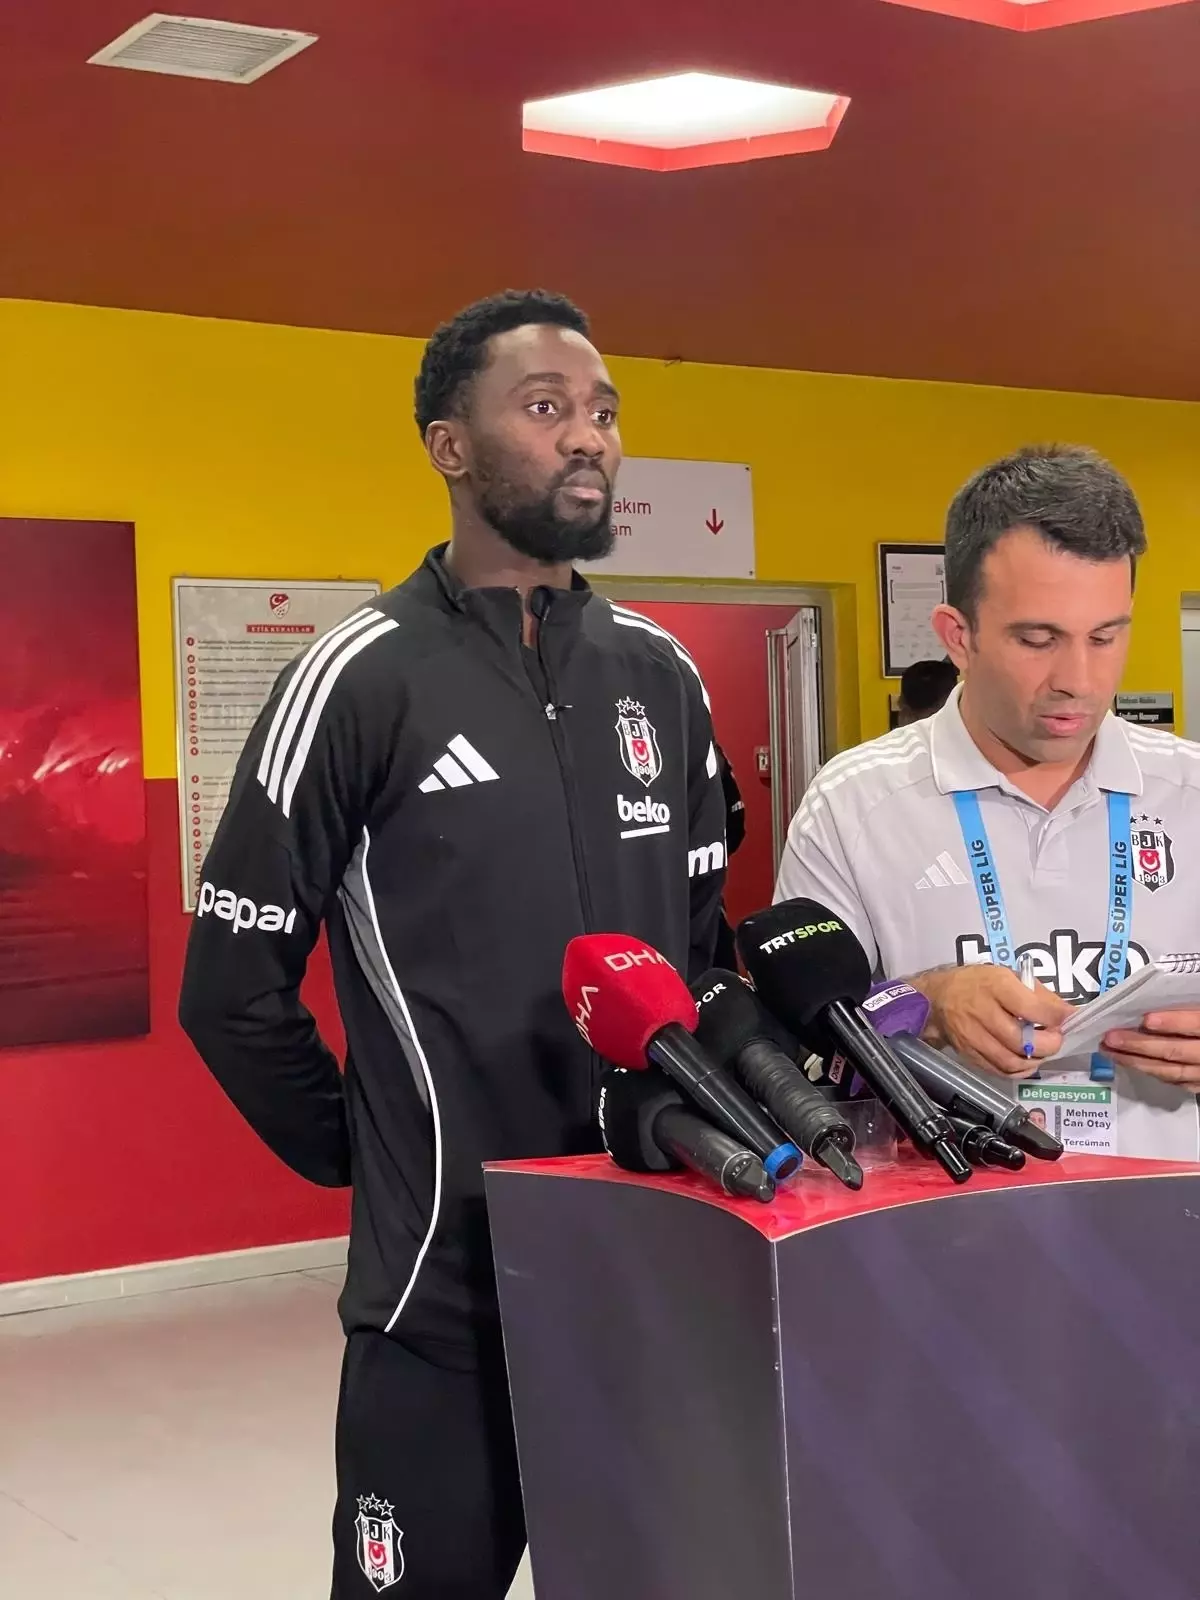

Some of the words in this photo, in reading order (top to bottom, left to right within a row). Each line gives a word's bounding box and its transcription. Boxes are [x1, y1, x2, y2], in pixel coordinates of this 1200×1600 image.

[613, 497, 652, 515] akım
[617, 794, 671, 824] beko
[1132, 833, 1164, 849] BJK
[1137, 873, 1167, 884] 1903
[980, 871, 1005, 932] SÜPER
[1108, 874, 1127, 933] SÜPER
[1105, 939, 1124, 991] DYOL
[1022, 1089, 1096, 1101] Delegasyon
[1099, 1090, 1107, 1101] 1
[1066, 1108, 1108, 1118] Mehmet
[1063, 1119, 1083, 1128] Can
[1087, 1119, 1111, 1130] Otay
[1064, 1138, 1110, 1147] Tercüman
[362, 1521, 391, 1540] BJK
